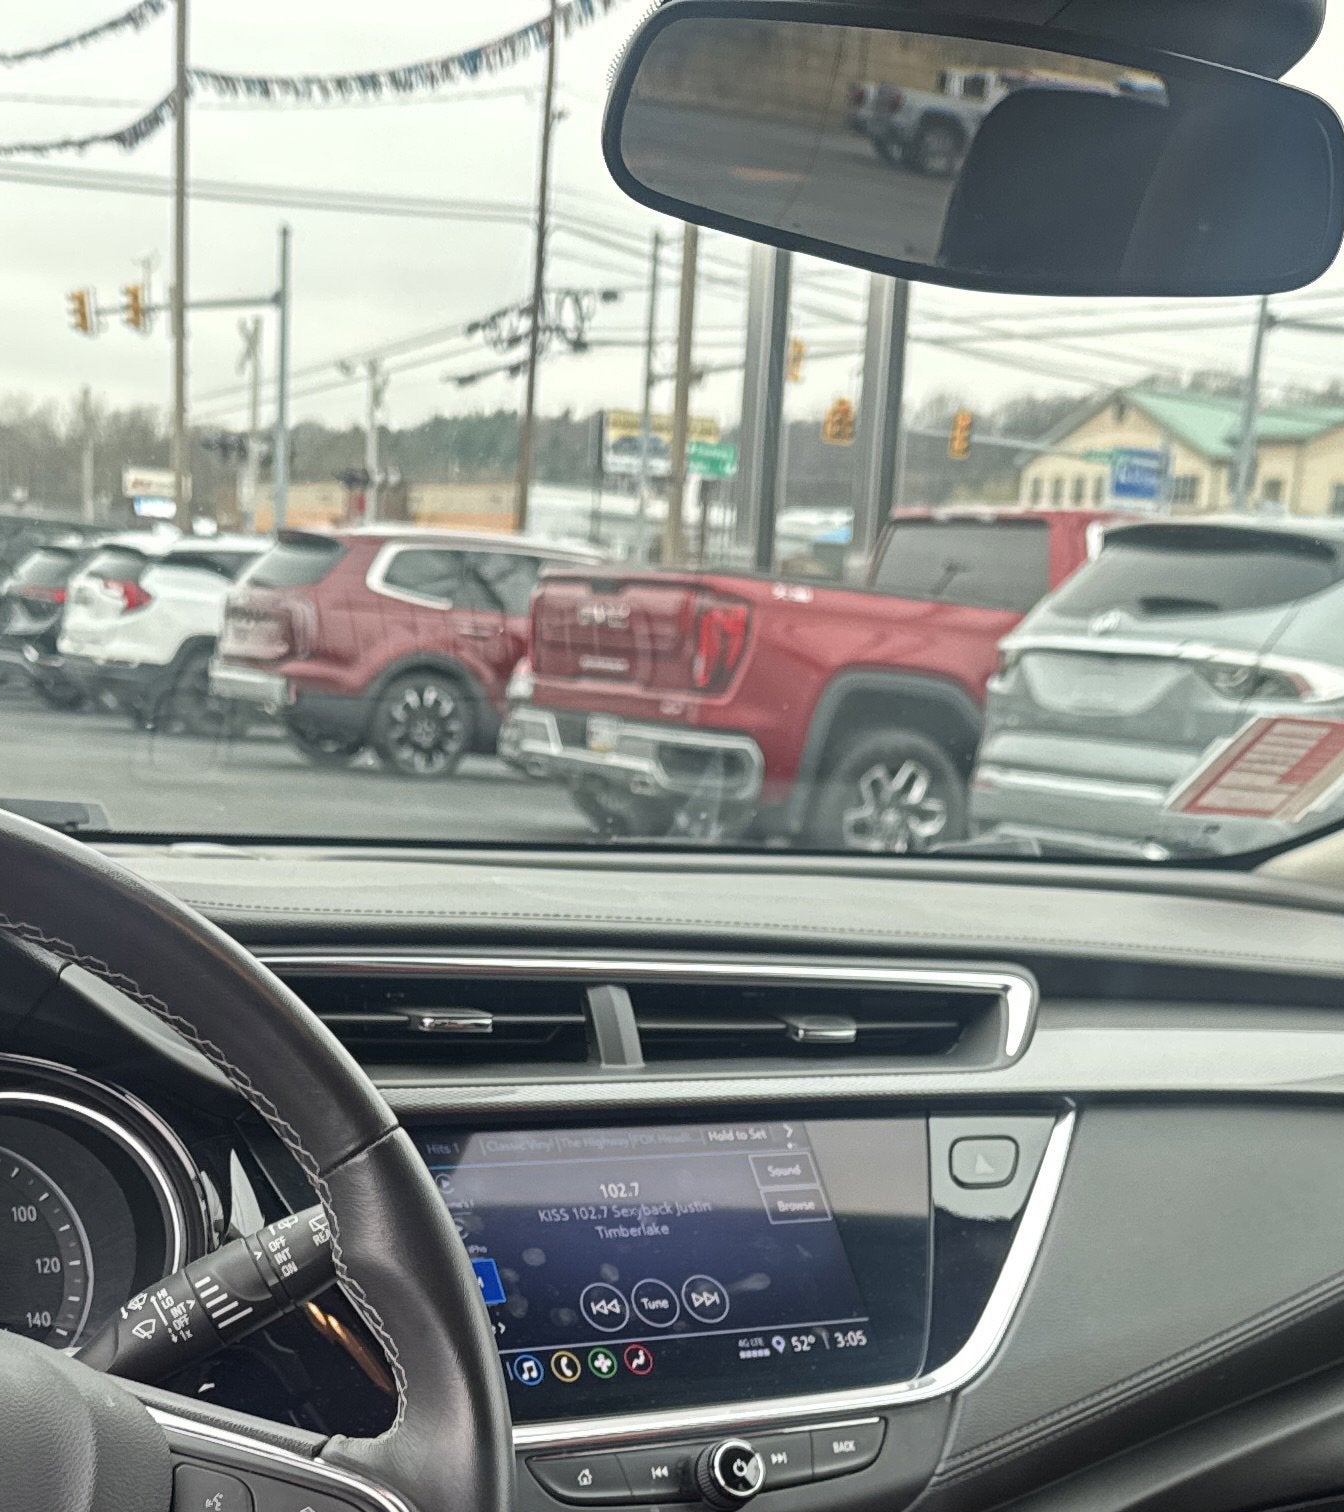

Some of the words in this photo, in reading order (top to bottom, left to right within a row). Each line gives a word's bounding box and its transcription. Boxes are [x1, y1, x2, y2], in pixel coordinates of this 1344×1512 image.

[707, 1129, 735, 1142] Hold
[736, 1129, 748, 1141] to
[750, 1127, 768, 1140] Set
[426, 1143, 451, 1154] Hits
[767, 1163, 802, 1177] Sound
[599, 1182, 641, 1199] 102.7
[11, 1205, 37, 1222] 100
[538, 1208, 570, 1223] KISS
[572, 1205, 610, 1221] 102.7
[611, 1201, 673, 1222] Sexyback
[675, 1199, 712, 1216] Justin
[777, 1199, 816, 1213] Browse
[594, 1222, 671, 1240] Timberlake
[268, 1236, 287, 1253] OFF
[274, 1248, 291, 1265] INT
[35, 1257, 61, 1274] 120
[281, 1261, 299, 1278] ON
[156, 1287, 168, 1300] HI
[161, 1297, 175, 1310] LO
[169, 1301, 187, 1318] INT
[640, 1297, 669, 1311] Tune
[26, 1311, 51, 1328] 140
[172, 1314, 190, 1331] OFF
[179, 1329, 194, 1341] 1x
[833, 1331, 866, 1349] 3:05
[832, 1440, 856, 1454] BACK
